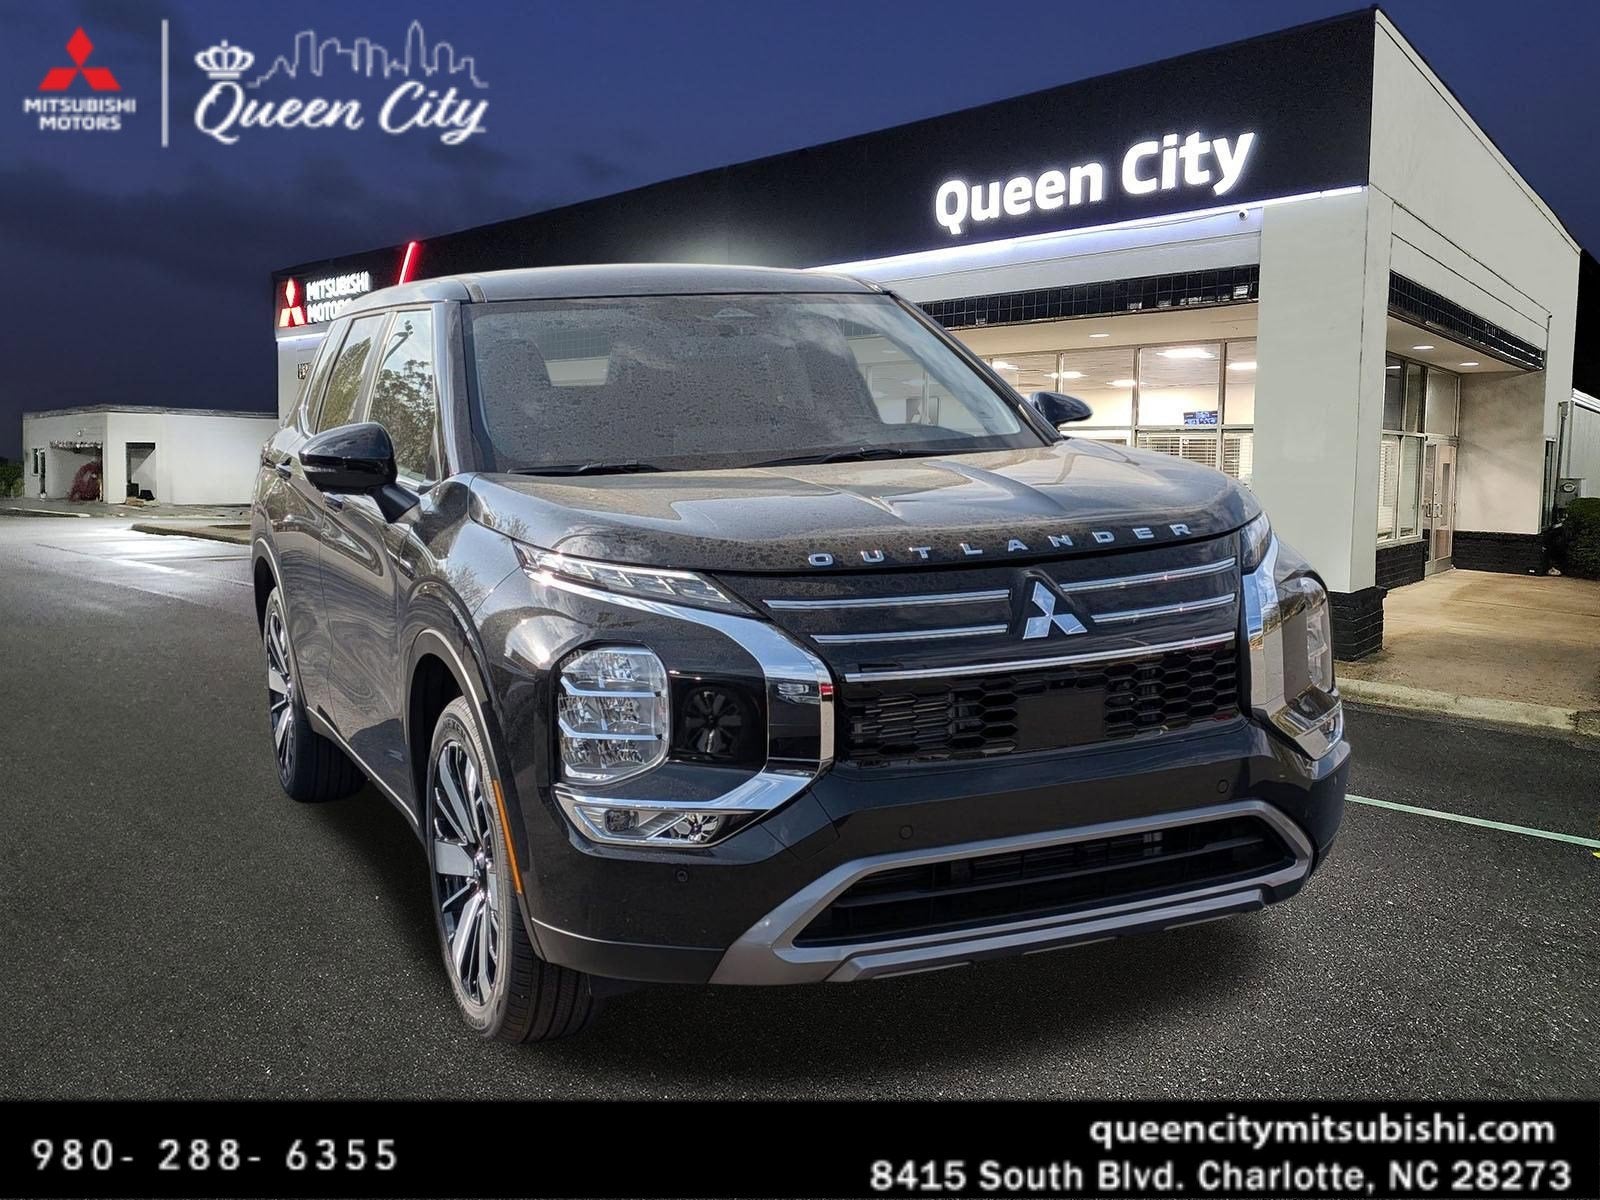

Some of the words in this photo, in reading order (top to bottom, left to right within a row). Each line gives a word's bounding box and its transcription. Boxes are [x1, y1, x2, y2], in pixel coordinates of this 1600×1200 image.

[935, 161, 1104, 235] Queen
[1121, 131, 1256, 197] City
[306, 270, 371, 302] MITSUBISHI
[807, 522, 1193, 568] OUTLANDER
